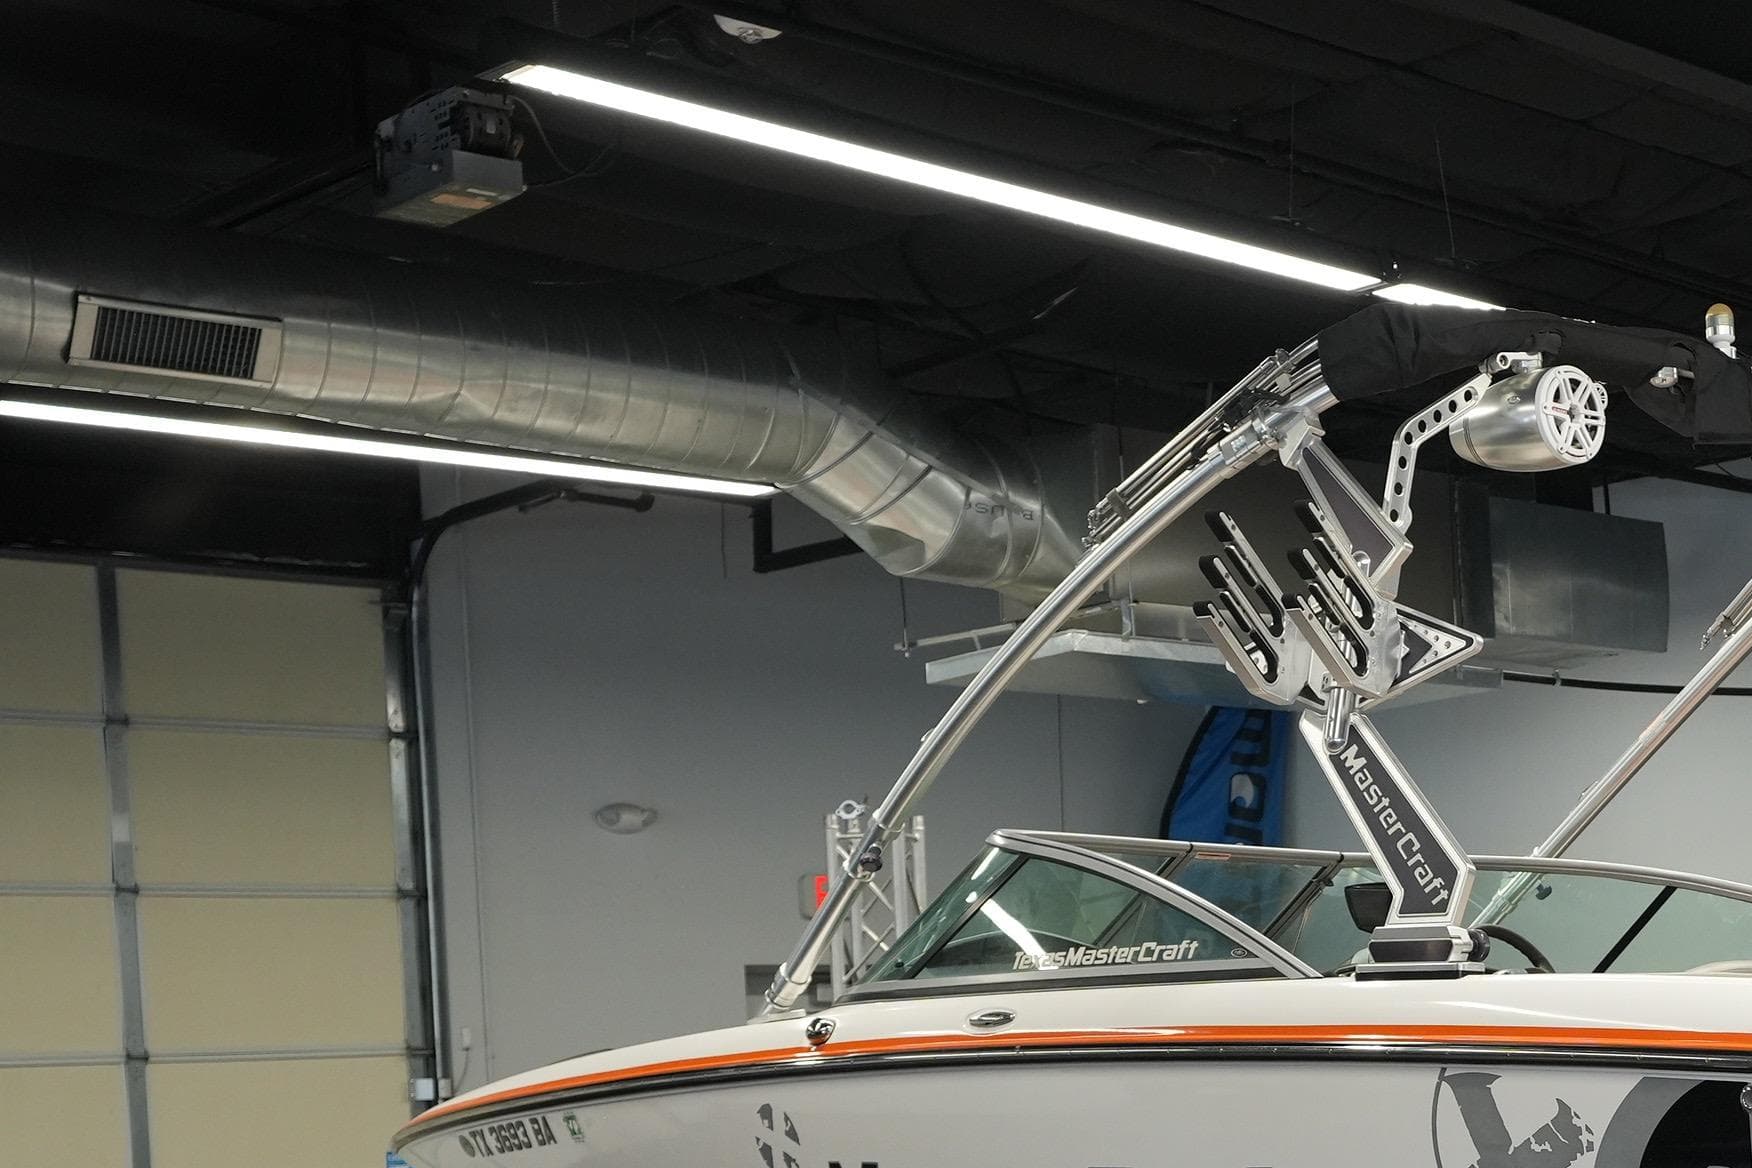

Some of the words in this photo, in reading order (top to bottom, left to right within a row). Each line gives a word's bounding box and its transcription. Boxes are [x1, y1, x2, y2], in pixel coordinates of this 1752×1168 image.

[1340, 744, 1449, 905] MasterCraft
[468, 1128, 494, 1158] TX
[529, 1115, 557, 1146] BA
